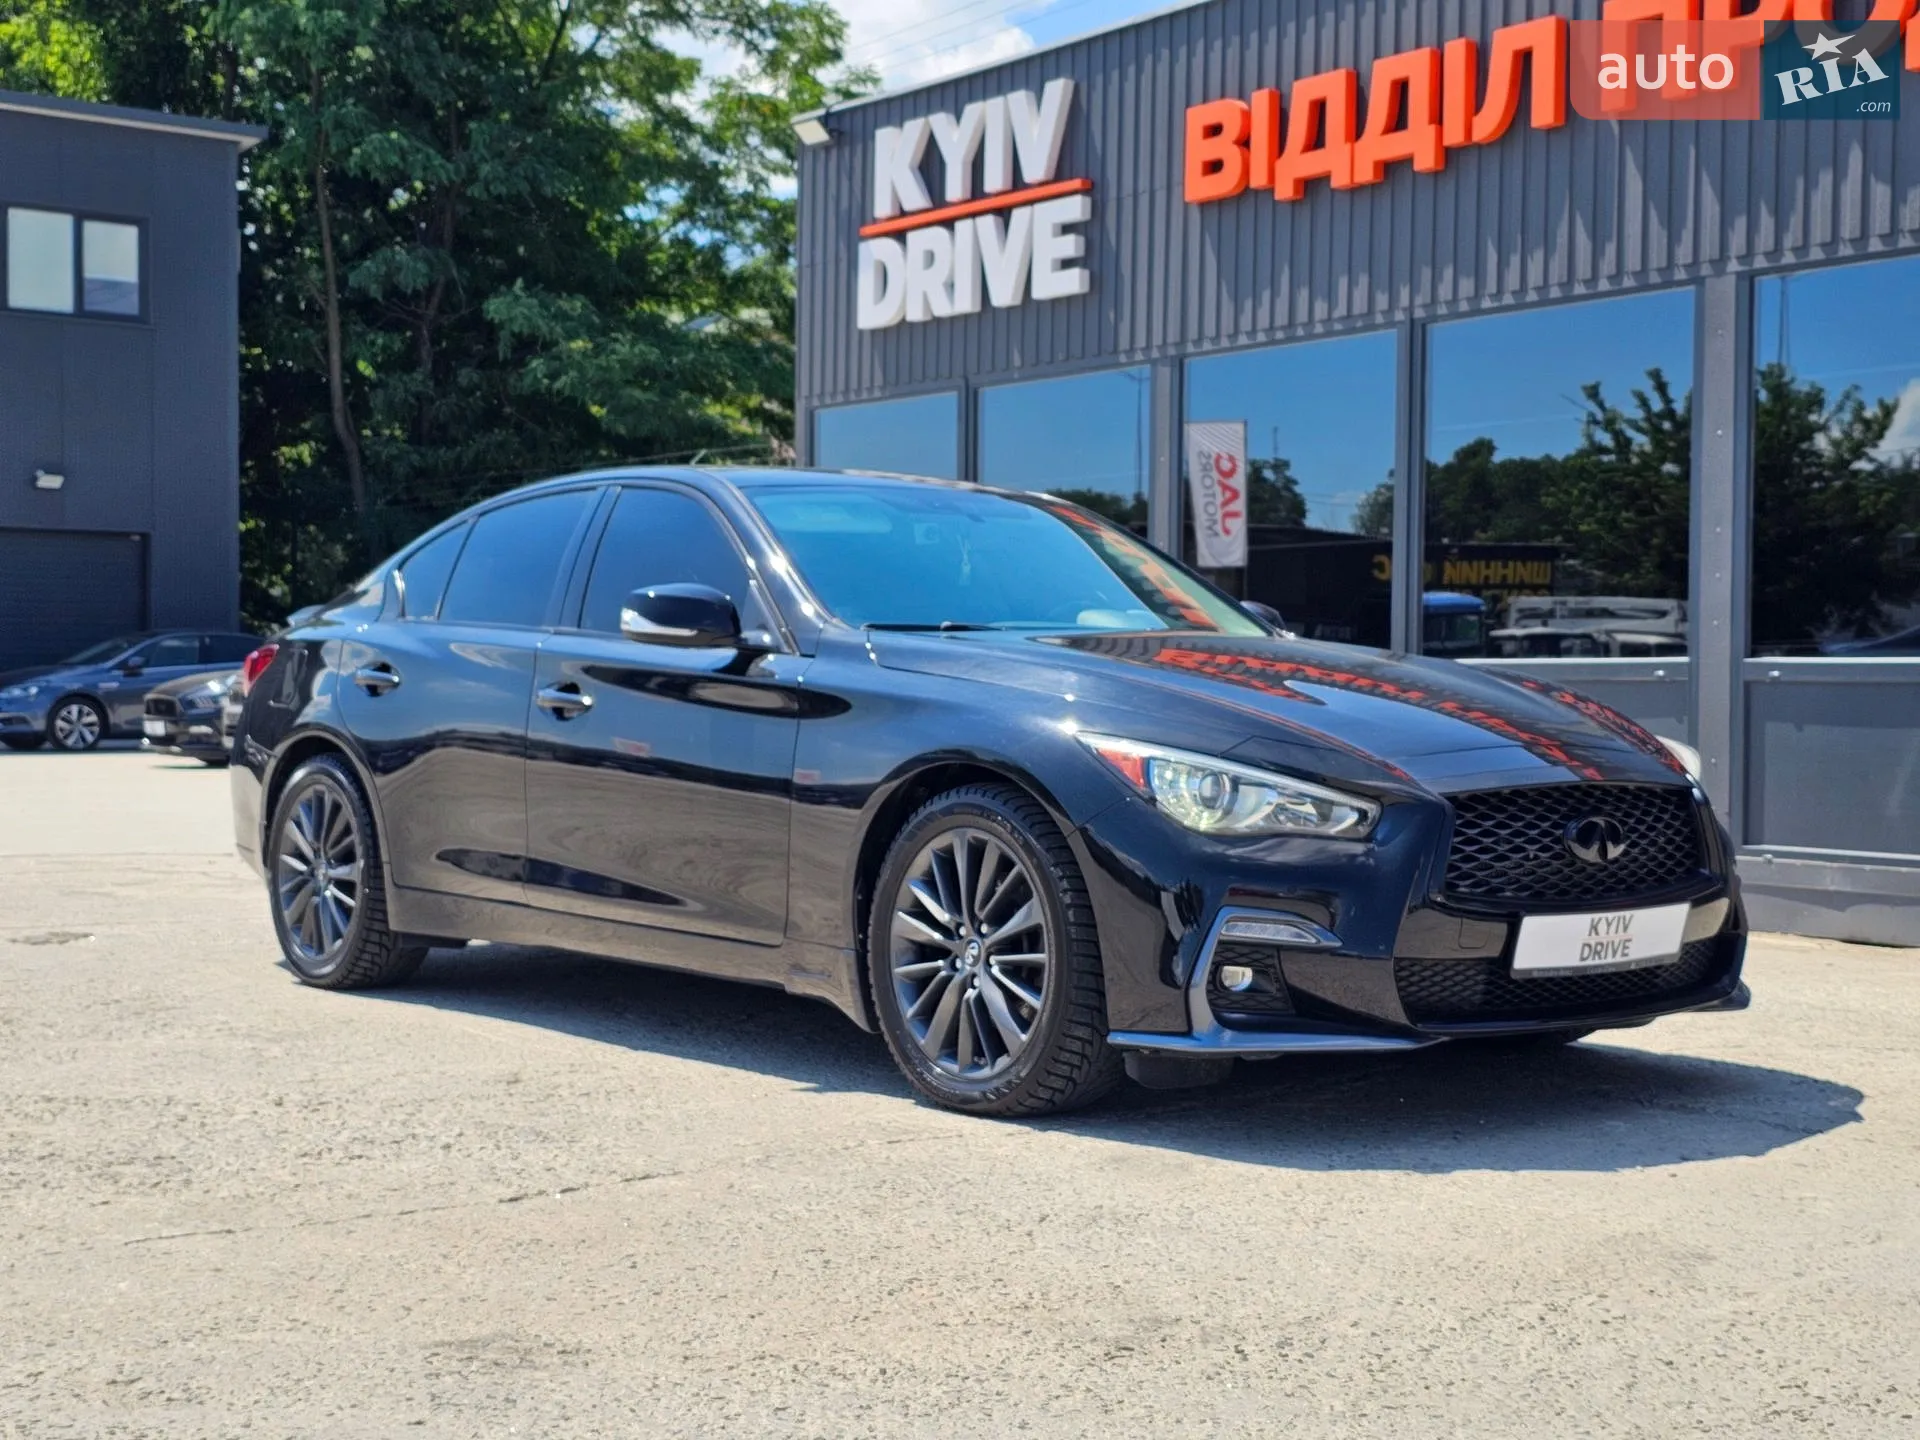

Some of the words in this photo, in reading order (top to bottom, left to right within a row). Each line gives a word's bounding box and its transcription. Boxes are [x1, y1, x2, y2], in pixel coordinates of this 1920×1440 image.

[873, 77, 1075, 219] KYIV
[1184, 15, 1567, 202] ВІДДІЛ
[857, 194, 1092, 330] DRIVE
[1579, 938, 1633, 962] DRIVE
[1588, 914, 1634, 937] KYIV
